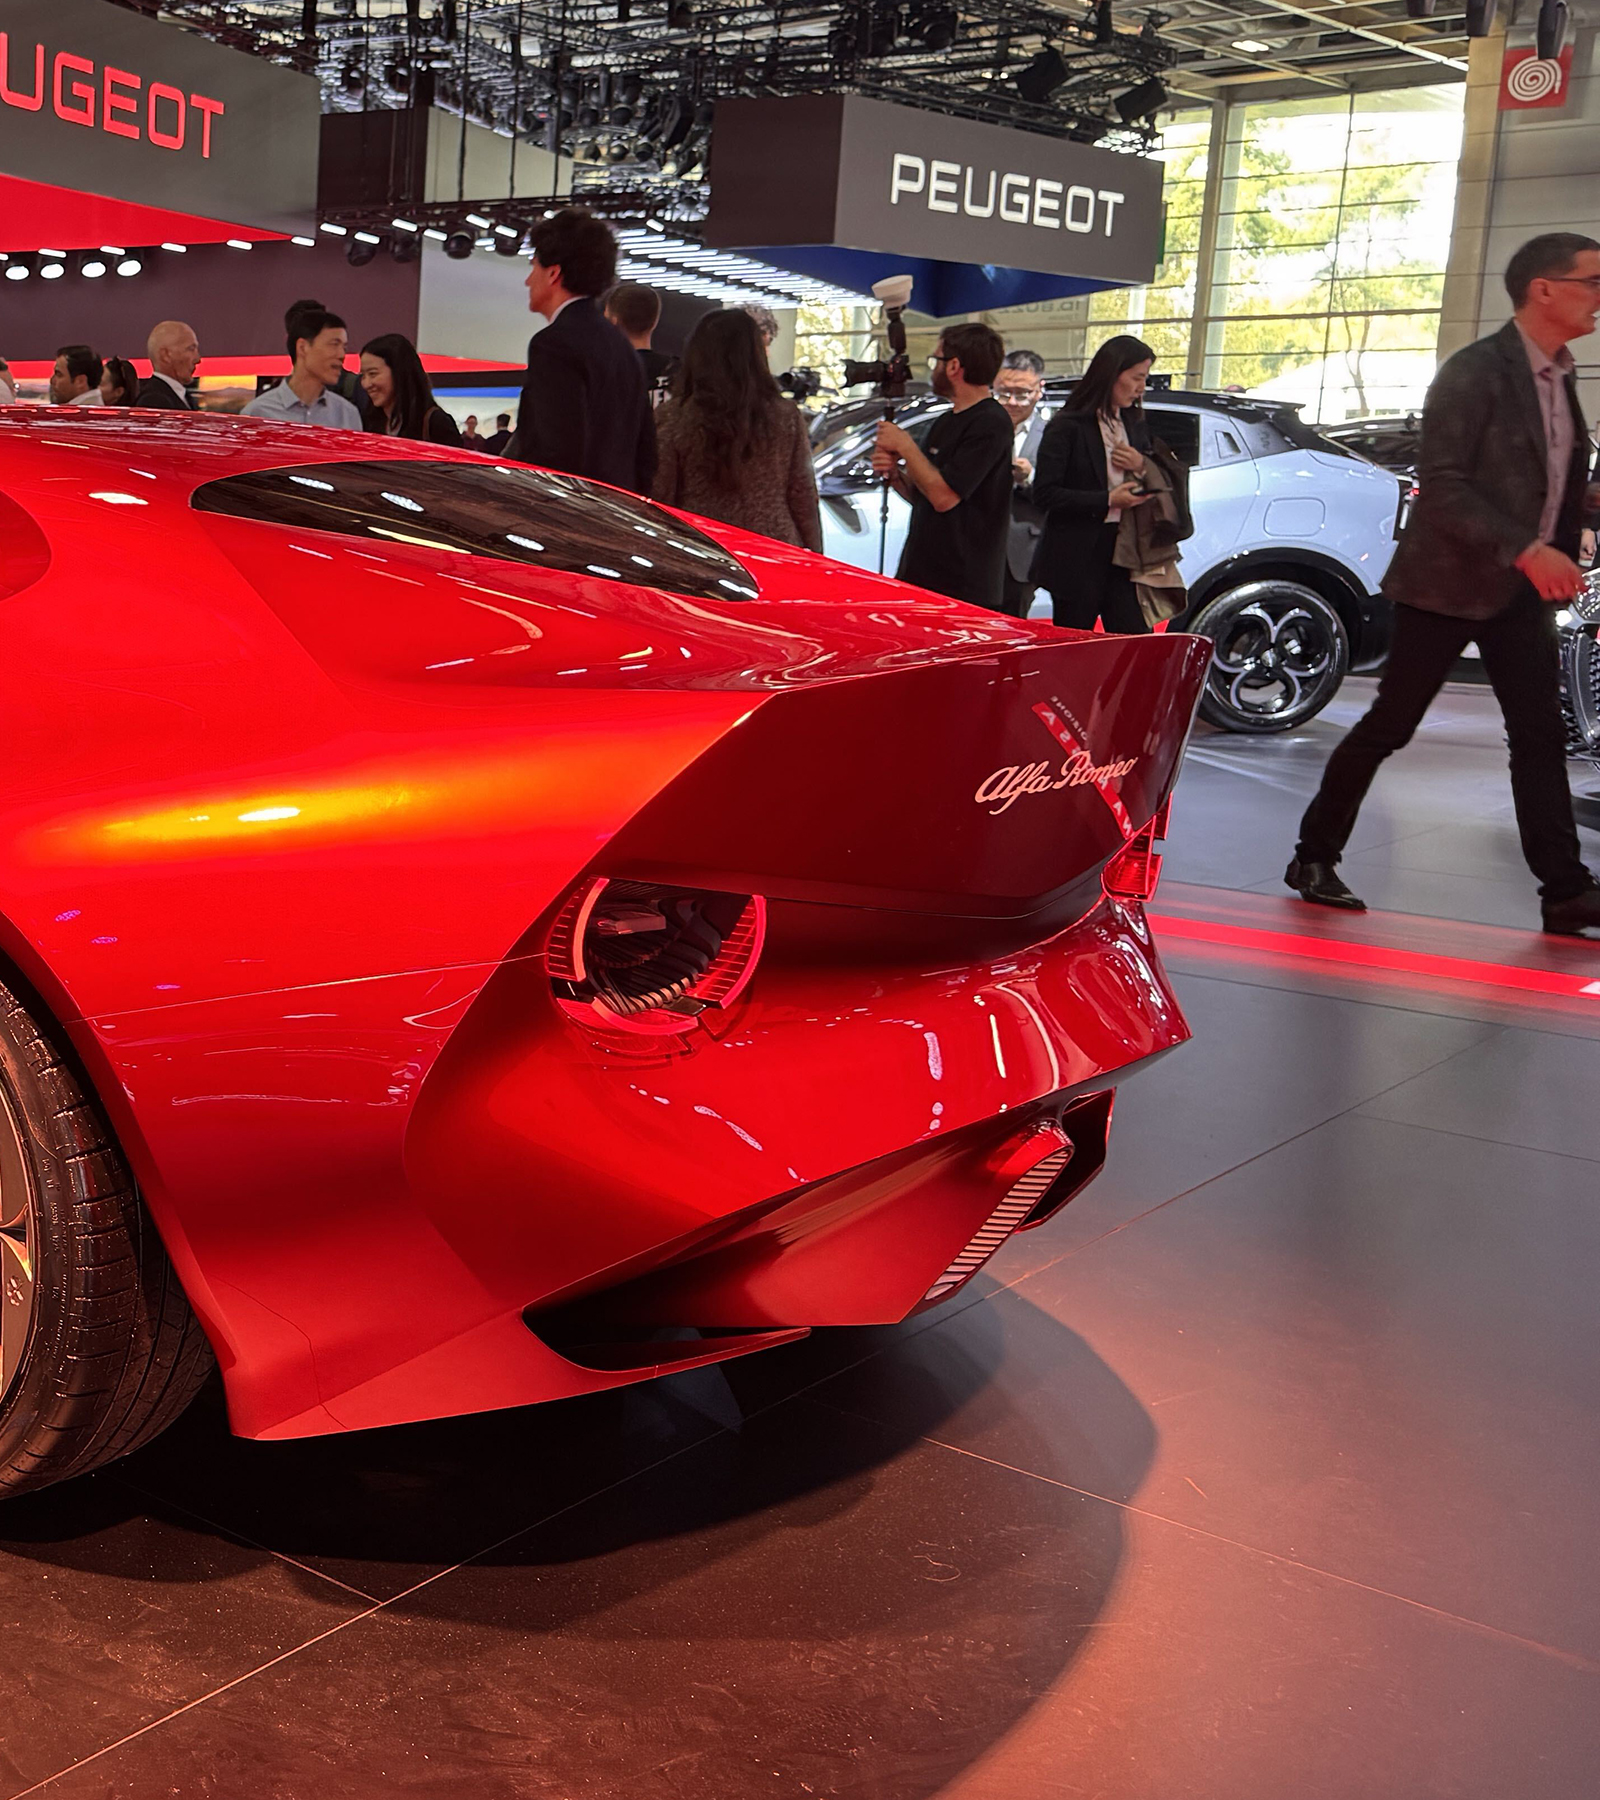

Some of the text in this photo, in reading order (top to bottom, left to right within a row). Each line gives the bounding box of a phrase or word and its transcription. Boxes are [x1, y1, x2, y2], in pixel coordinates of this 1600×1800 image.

[891, 153, 1124, 237] PEUGEOT
[974, 750, 1138, 815] Alfa Romeo
